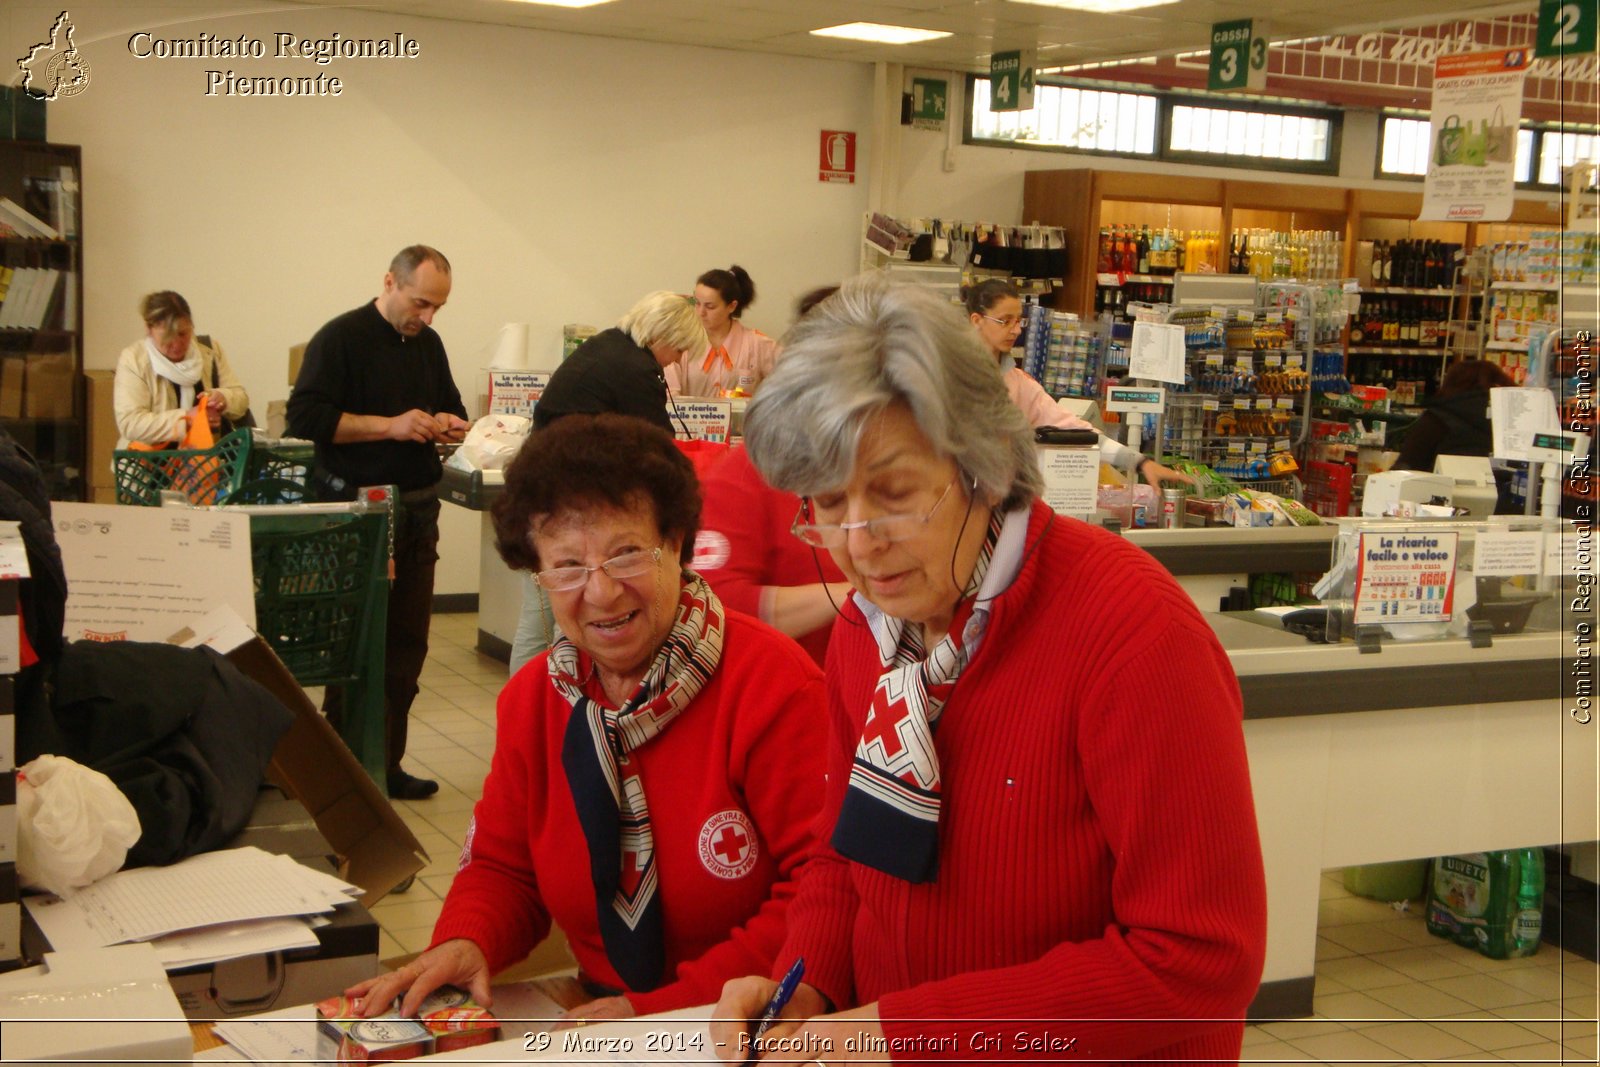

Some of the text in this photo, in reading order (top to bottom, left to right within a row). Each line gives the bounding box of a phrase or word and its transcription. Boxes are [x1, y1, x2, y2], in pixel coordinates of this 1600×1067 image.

[1551, 4, 1581, 47] 2
[1213, 28, 1249, 43] cassa
[1251, 37, 1266, 70] 3
[992, 59, 1019, 71] cassa
[1220, 47, 1237, 82] 3
[1020, 67, 1033, 94] 4
[997, 75, 1010, 103] 4
[495, 380, 513, 388] facile
[523, 380, 545, 388] veloce
[676, 404, 718, 412] La ricarica
[700, 412, 726, 420] veloce
[1380, 536, 1438, 549] La ricarica
[1367, 549, 1448, 561] facile e veloce
[703, 827, 711, 836] DI
[708, 812, 738, 829] GINEVRA
